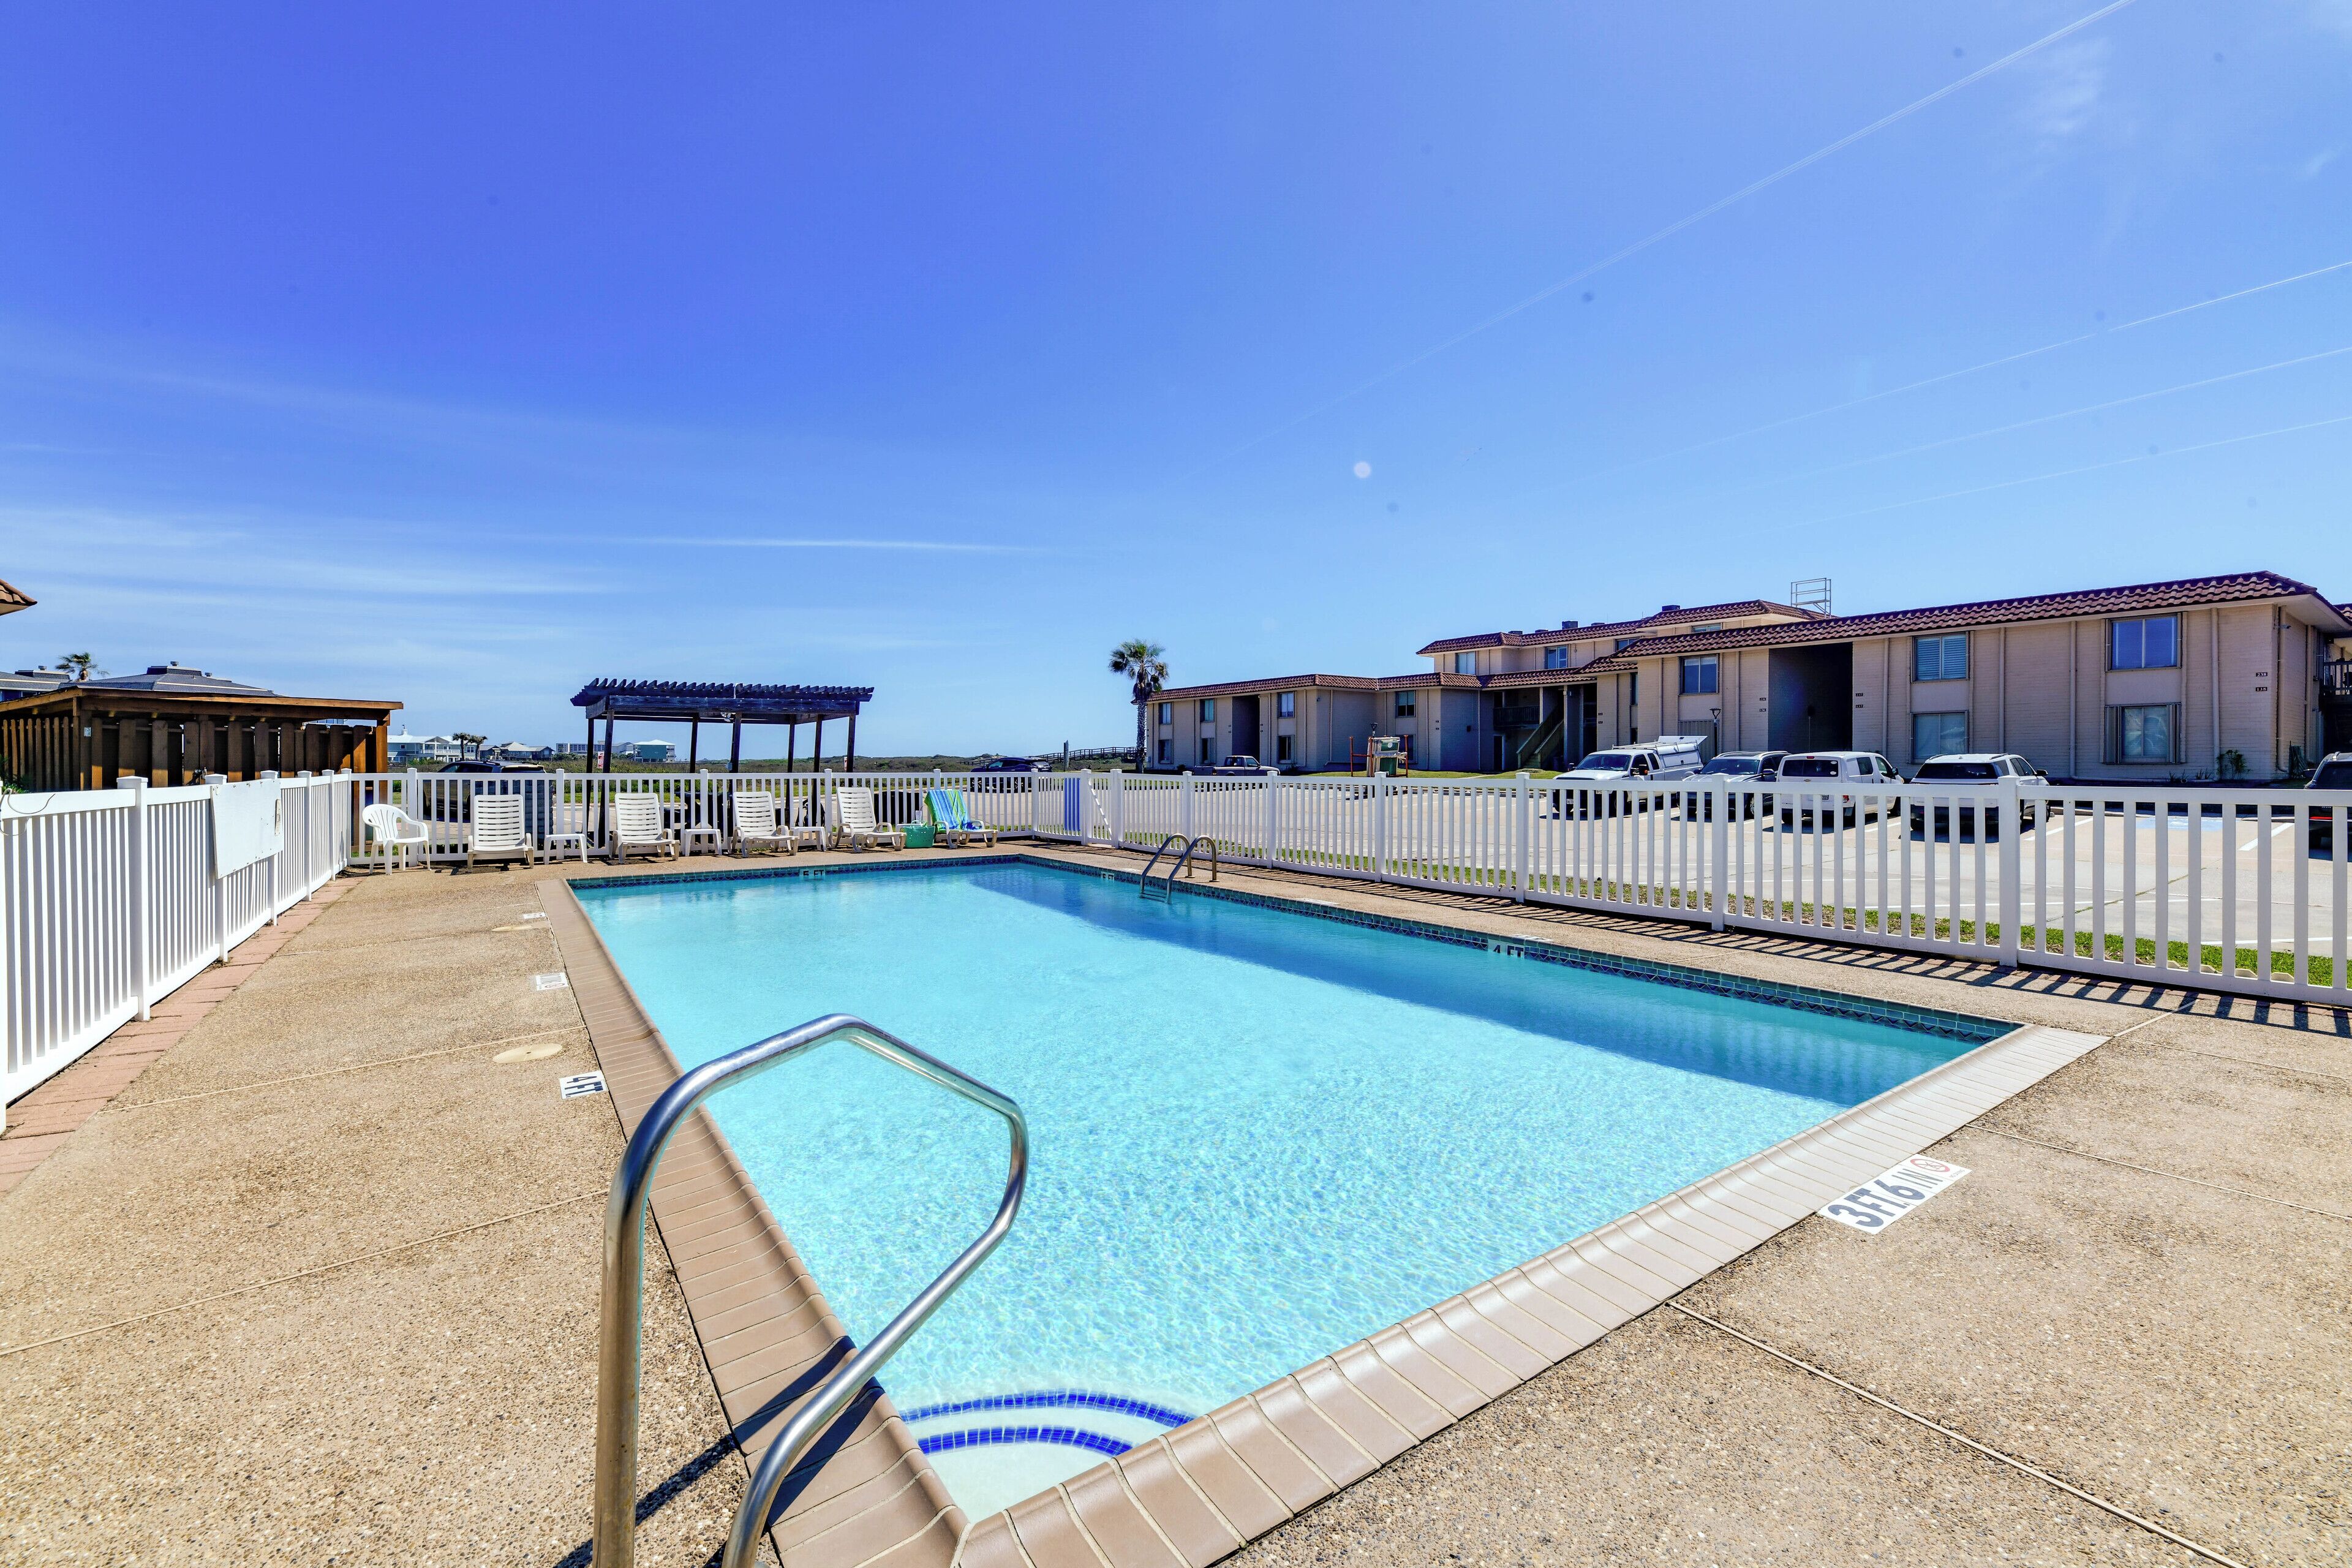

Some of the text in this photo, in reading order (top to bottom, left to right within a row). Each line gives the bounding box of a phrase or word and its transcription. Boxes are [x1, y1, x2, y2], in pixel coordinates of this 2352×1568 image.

[1507, 945, 1524, 957] FT
[1891, 1168, 1943, 1189] IN
[1874, 1179, 1925, 1200] 6
[1828, 1204, 1884, 1227] 3
